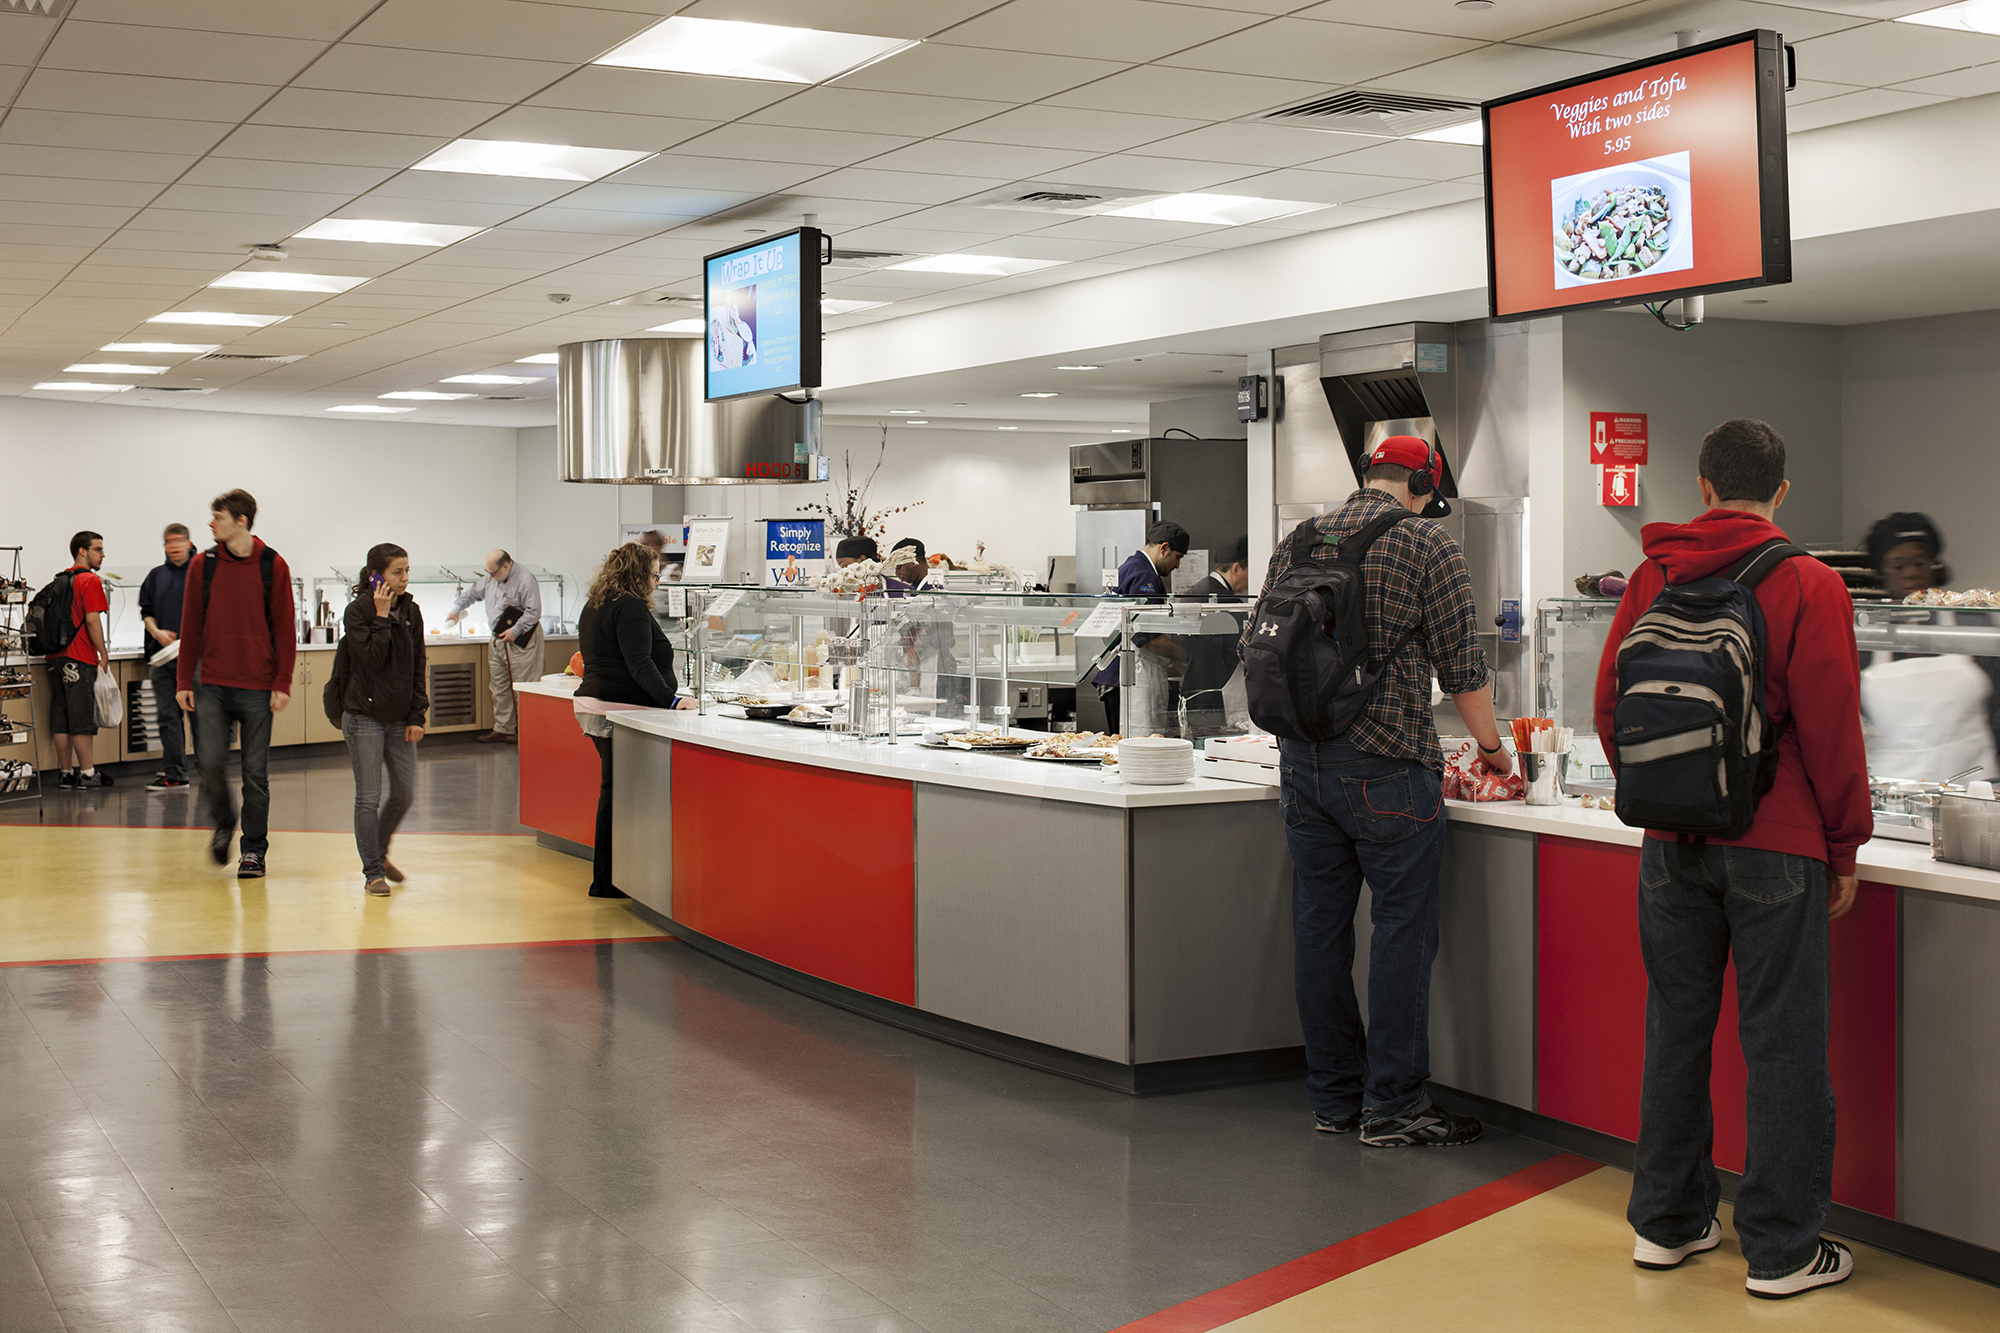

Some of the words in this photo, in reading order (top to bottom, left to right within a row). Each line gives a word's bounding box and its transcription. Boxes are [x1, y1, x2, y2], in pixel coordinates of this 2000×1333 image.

[1550, 95, 1608, 123] Veggies
[1612, 80, 1648, 106] and
[1648, 72, 1687, 101] Tofu
[1565, 116, 1601, 139] With
[1605, 114, 1632, 131] two
[1635, 101, 1670, 123] sides
[1603, 135, 1632, 155] 5.95
[722, 260, 750, 283] Wrap
[753, 255, 763, 276] It
[767, 248, 783, 272] Up
[746, 462, 791, 477] HOOD
[795, 462, 801, 477] 6
[780, 526, 811, 541] Simply
[770, 540, 821, 555] Recognize
